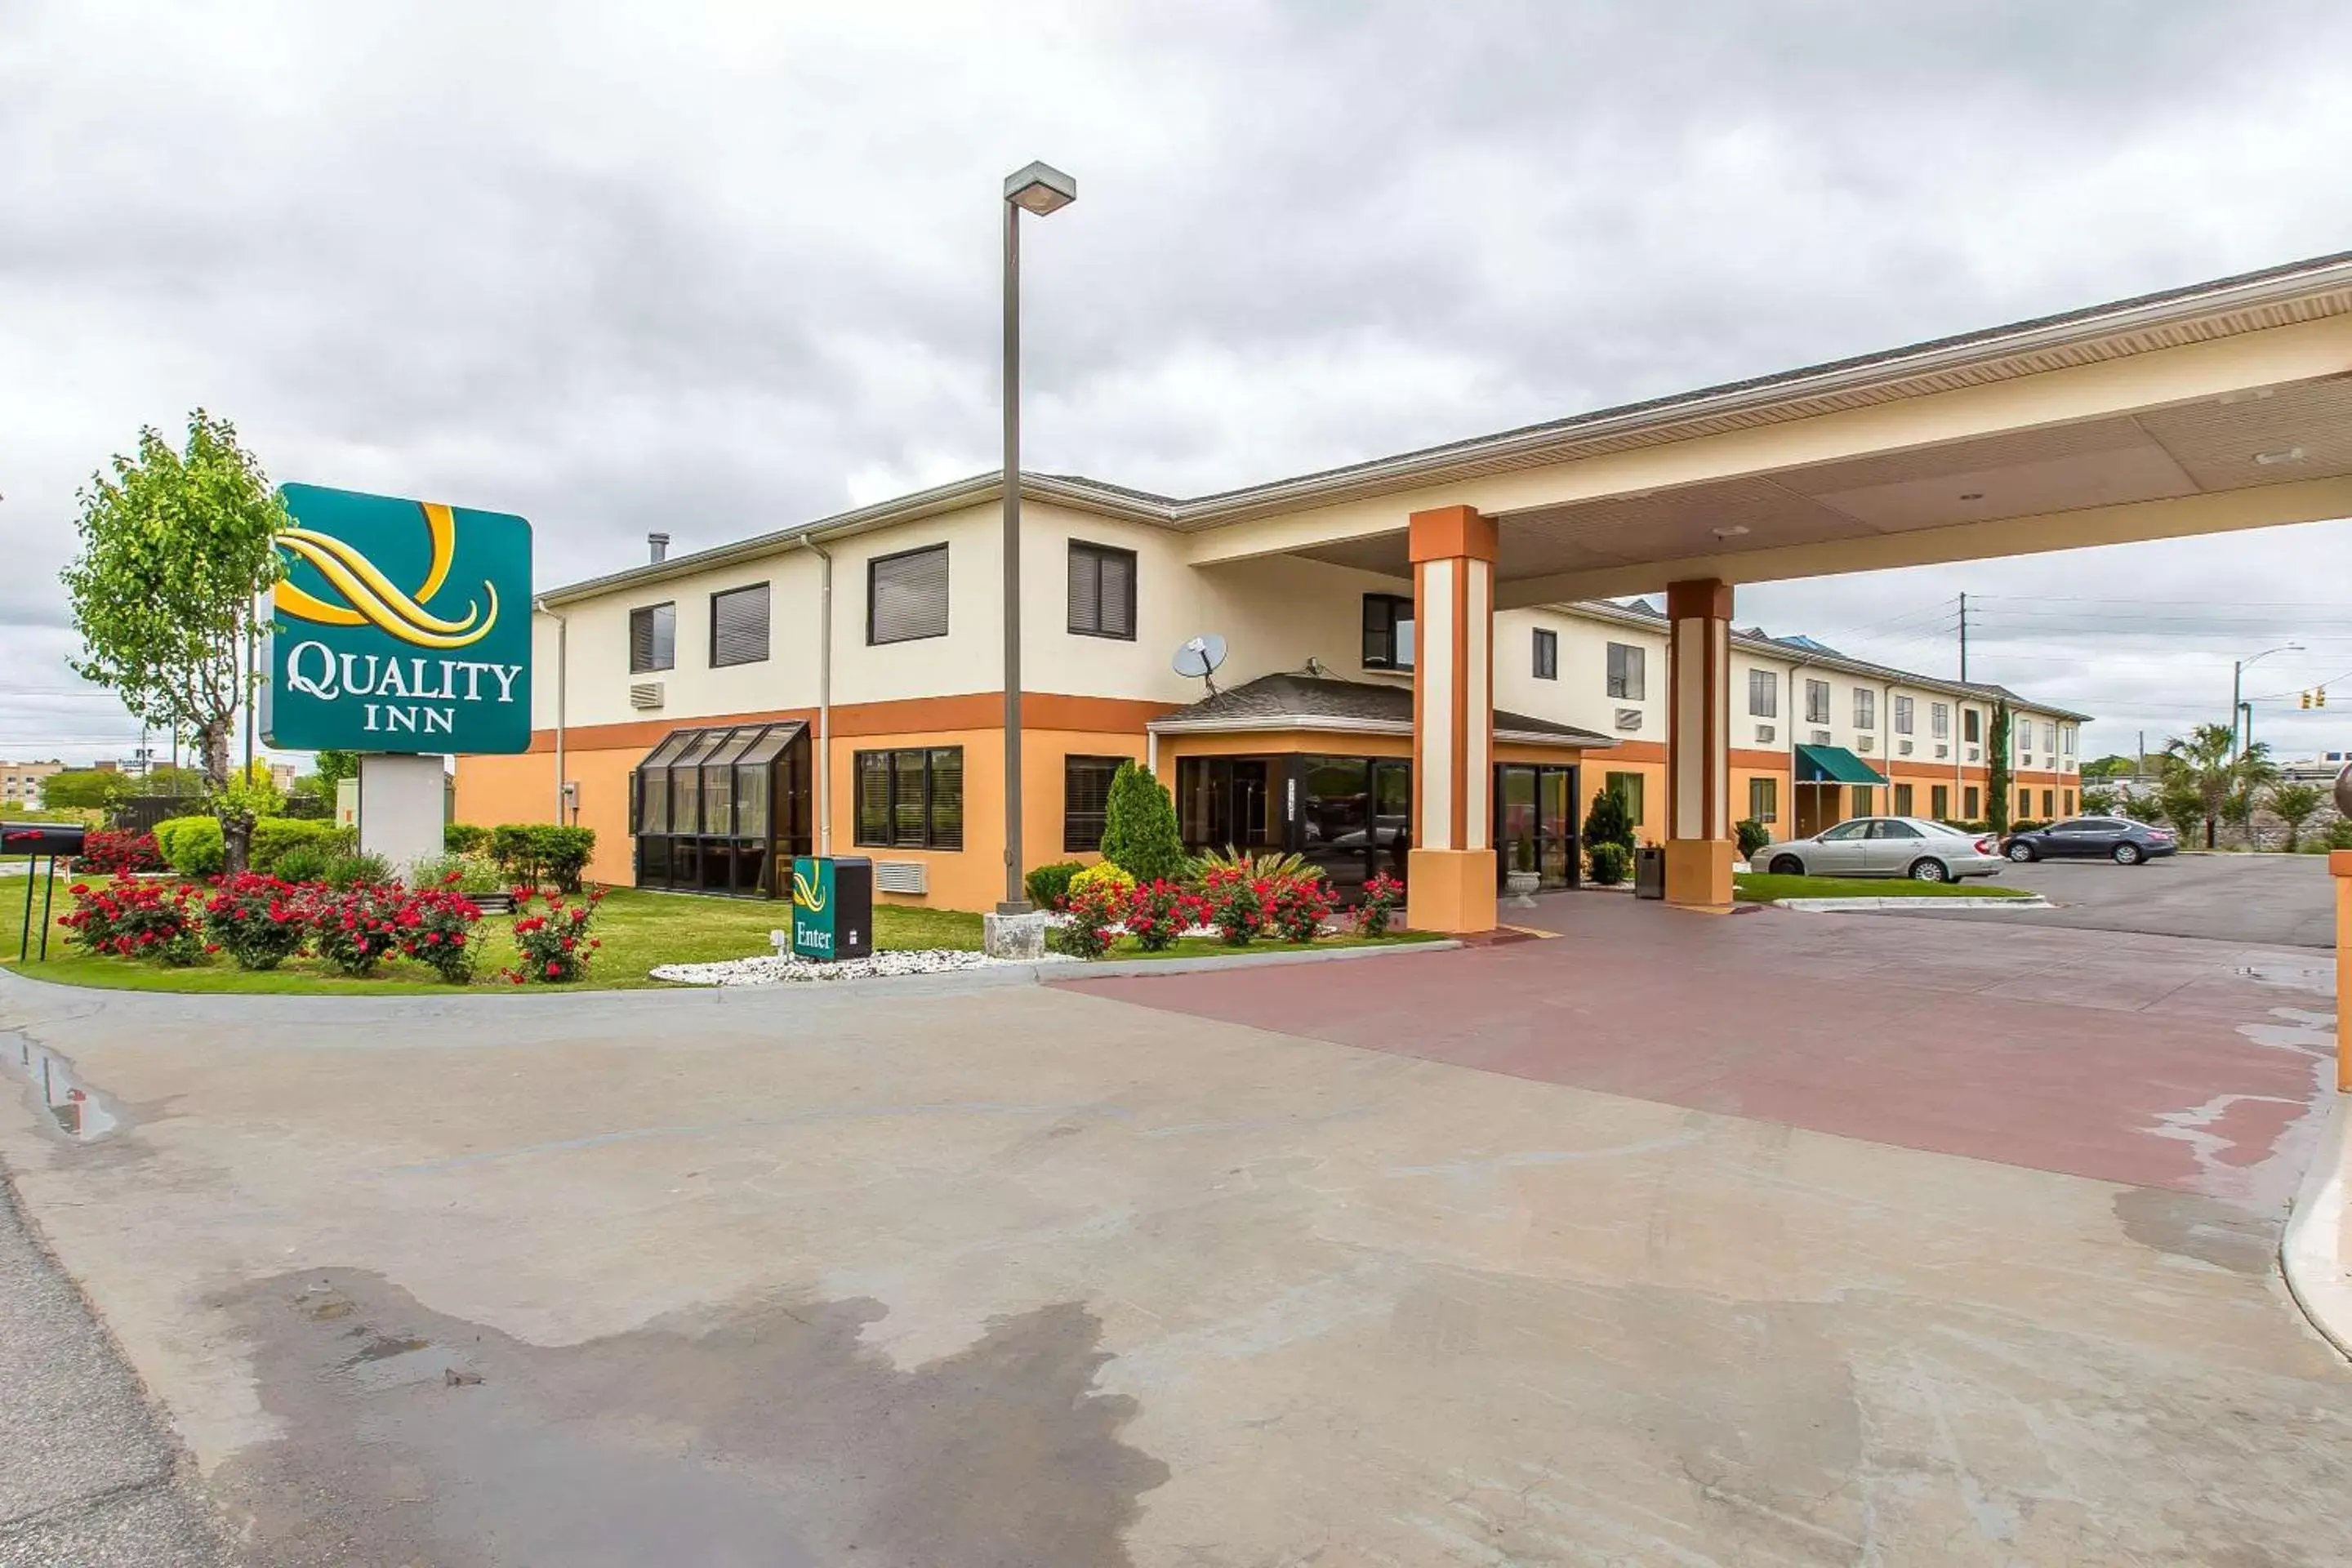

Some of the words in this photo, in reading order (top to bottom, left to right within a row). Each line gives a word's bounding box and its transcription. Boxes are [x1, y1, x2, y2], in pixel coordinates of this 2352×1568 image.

[288, 641, 523, 702] QUALITY
[363, 704, 454, 733] INN
[797, 921, 831, 949] Enter
